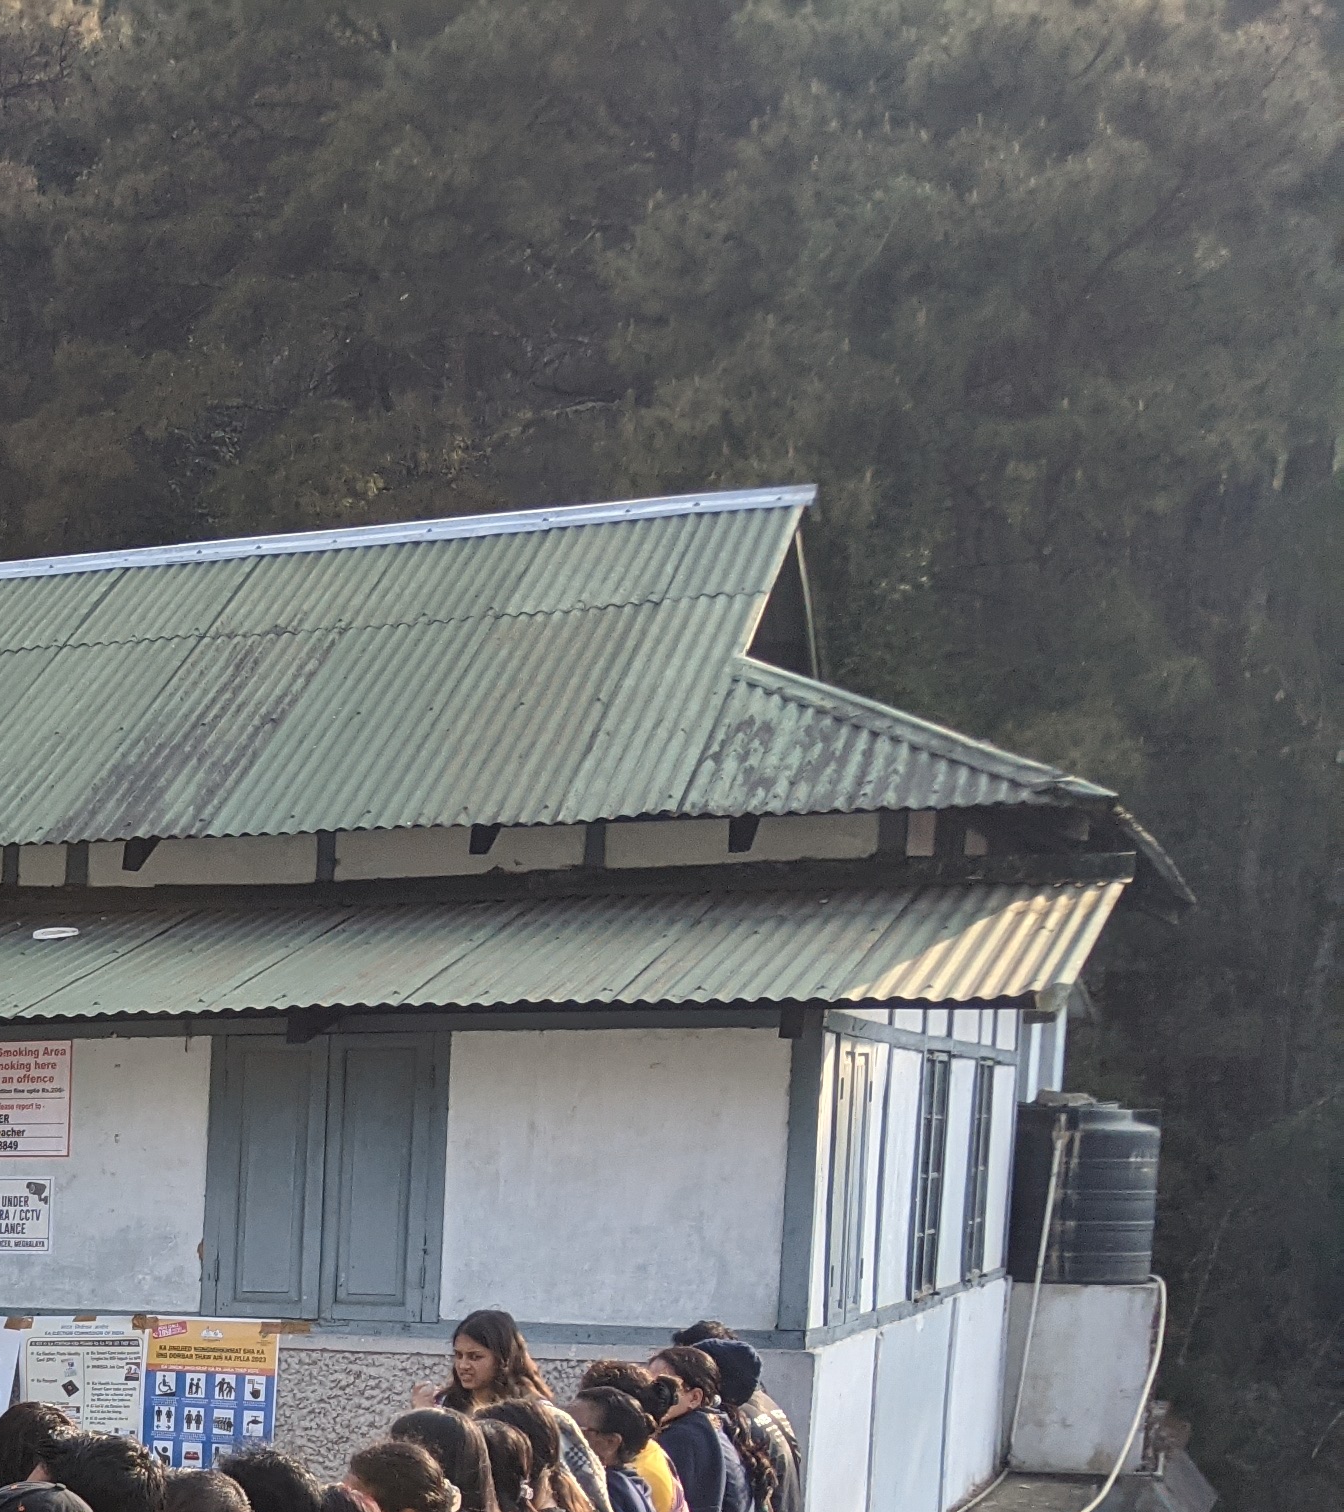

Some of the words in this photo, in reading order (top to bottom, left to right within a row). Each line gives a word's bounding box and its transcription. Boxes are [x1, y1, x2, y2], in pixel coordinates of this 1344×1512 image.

[42, 1047, 66, 1056] Area
[35, 1060, 57, 1069] here
[2, 1076, 13, 1084] an
[17, 1074, 54, 1084] offence
[2, 1196, 29, 1207] UNDER
[20, 1209, 41, 1221] CCTV
